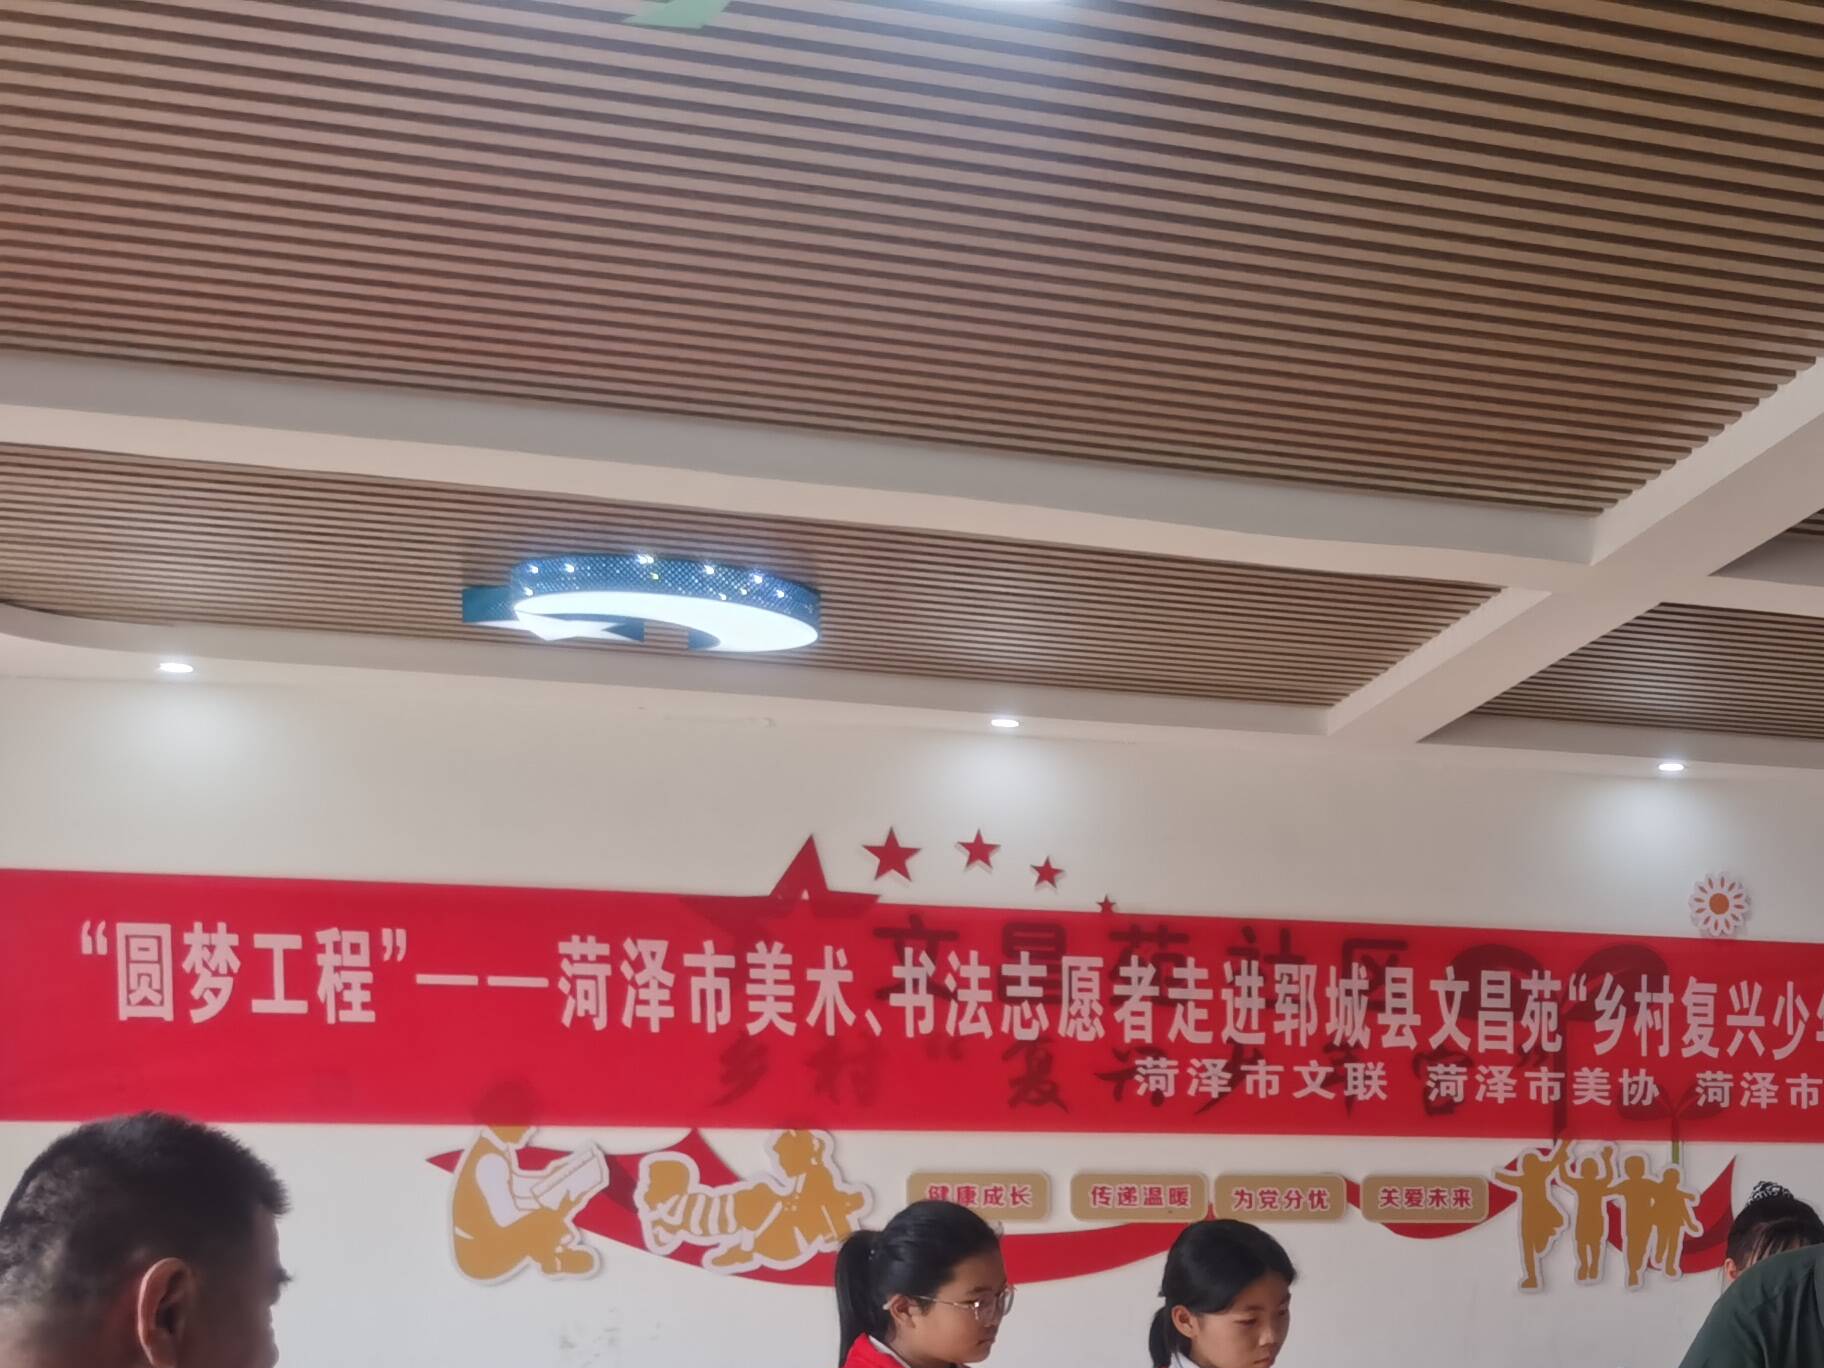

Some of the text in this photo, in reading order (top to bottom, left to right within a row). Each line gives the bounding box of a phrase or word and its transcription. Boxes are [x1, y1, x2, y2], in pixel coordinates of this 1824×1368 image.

[1134, 1057, 1388, 1102] 菏泽市文联
[1426, 1063, 1660, 1107] 菏泽市美协
[926, 1184, 1033, 1208] 健康成长
[1089, 1184, 1193, 1209] 传递温暖
[1232, 1187, 1332, 1211] 为党分优
[1379, 1186, 1475, 1209] 关爱未来
